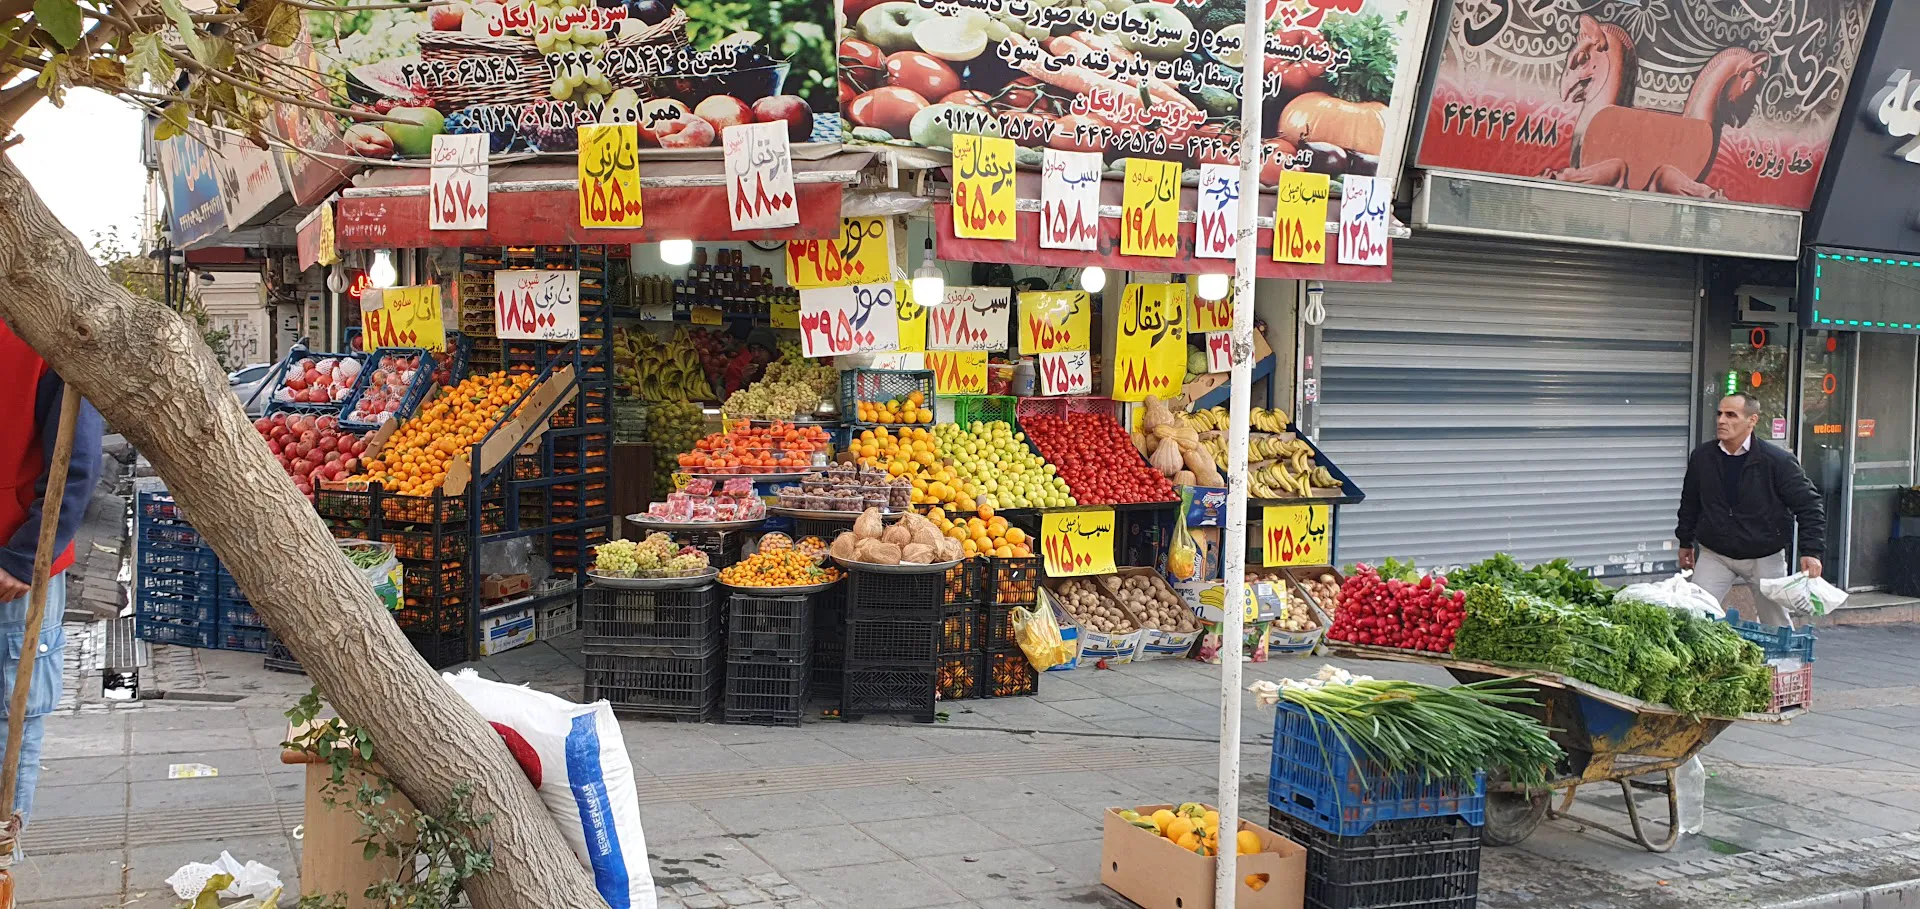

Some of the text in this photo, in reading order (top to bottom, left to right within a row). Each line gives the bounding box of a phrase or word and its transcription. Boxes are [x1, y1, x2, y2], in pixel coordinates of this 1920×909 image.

[488, 3, 627, 36] سرویس رایگان
[1009, 0, 1071, 27] صورت
[1077, 9, 1096, 32] به
[1101, 12, 1183, 45] سبزیجات
[998, 38, 1039, 69] شود
[1186, 32, 1200, 51] و
[1202, 34, 1241, 53] میوه
[1306, 42, 1351, 72] عرضه
[402, 57, 518, 89] ۴۴۴۰۶۵۴۵
[546, 45, 671, 78] ۴۴۴۰۶۵۴۴
[1044, 52, 1075, 72] می
[1082, 47, 1150, 84] پذیرفته
[1155, 57, 1233, 91] سفارشات
[462, 101, 604, 131] ۰۹۱۲۷۰۲۵۲۰۷
[934, 108, 1055, 142] ۰۹۱۲۷۰۲۵۲۰۷
[1070, 89, 1207, 130] سرویس رایگان
[584, 125, 636, 183] نارنگی
[735, 127, 788, 181] پرتقال
[1076, 125, 1165, 154] ۴۴۴۰۶۵۴۵
[960, 136, 1012, 196] پرتقال
[1062, 170, 1099, 190] سیب
[1790, 152, 1812, 174] خط
[433, 180, 486, 223] ۱۵۷۰۰
[581, 177, 642, 222] ۱۵۵۰۰
[735, 172, 793, 221] ۸۸۰۰
[956, 181, 1007, 230] ۹۵۰۰
[1145, 163, 1178, 210] انار
[1301, 186, 1327, 205] سیب
[1354, 178, 1386, 227] پیاز
[841, 217, 884, 261] موز
[1042, 200, 1097, 243] ۱۵۸۰۰
[1126, 207, 1175, 250] ۱۹۸۰۰
[1279, 217, 1321, 258] ۱۱۵۰۰
[1342, 220, 1384, 260] ۱۲۵۰۰
[788, 239, 865, 283] ۳۹۵۰۰
[393, 286, 436, 328] انار ساوه
[498, 289, 556, 333] ۱۸۵۰۰
[518, 273, 571, 310] نارنگی شیرین
[849, 285, 893, 331] موز
[972, 296, 1008, 316] سیب
[365, 309, 417, 350] ۱۹۸۰۰
[801, 308, 876, 355] ۳۹۵۰۰
[932, 306, 988, 345] ۱۷۸۰۰
[1029, 312, 1070, 351] ۷۵۰۰
[1124, 285, 1183, 349] پرتقال
[1043, 355, 1084, 393] ۷۵۰۰
[1058, 515, 1111, 539] سیب زمینی
[1268, 525, 1311, 562] ۱۲۵۰۰
[1300, 505, 1326, 545] پیاز
[1045, 533, 1092, 574] ۱۱۵۰۰
[582, 784, 609, 856] NEGIN SEPANDAR
